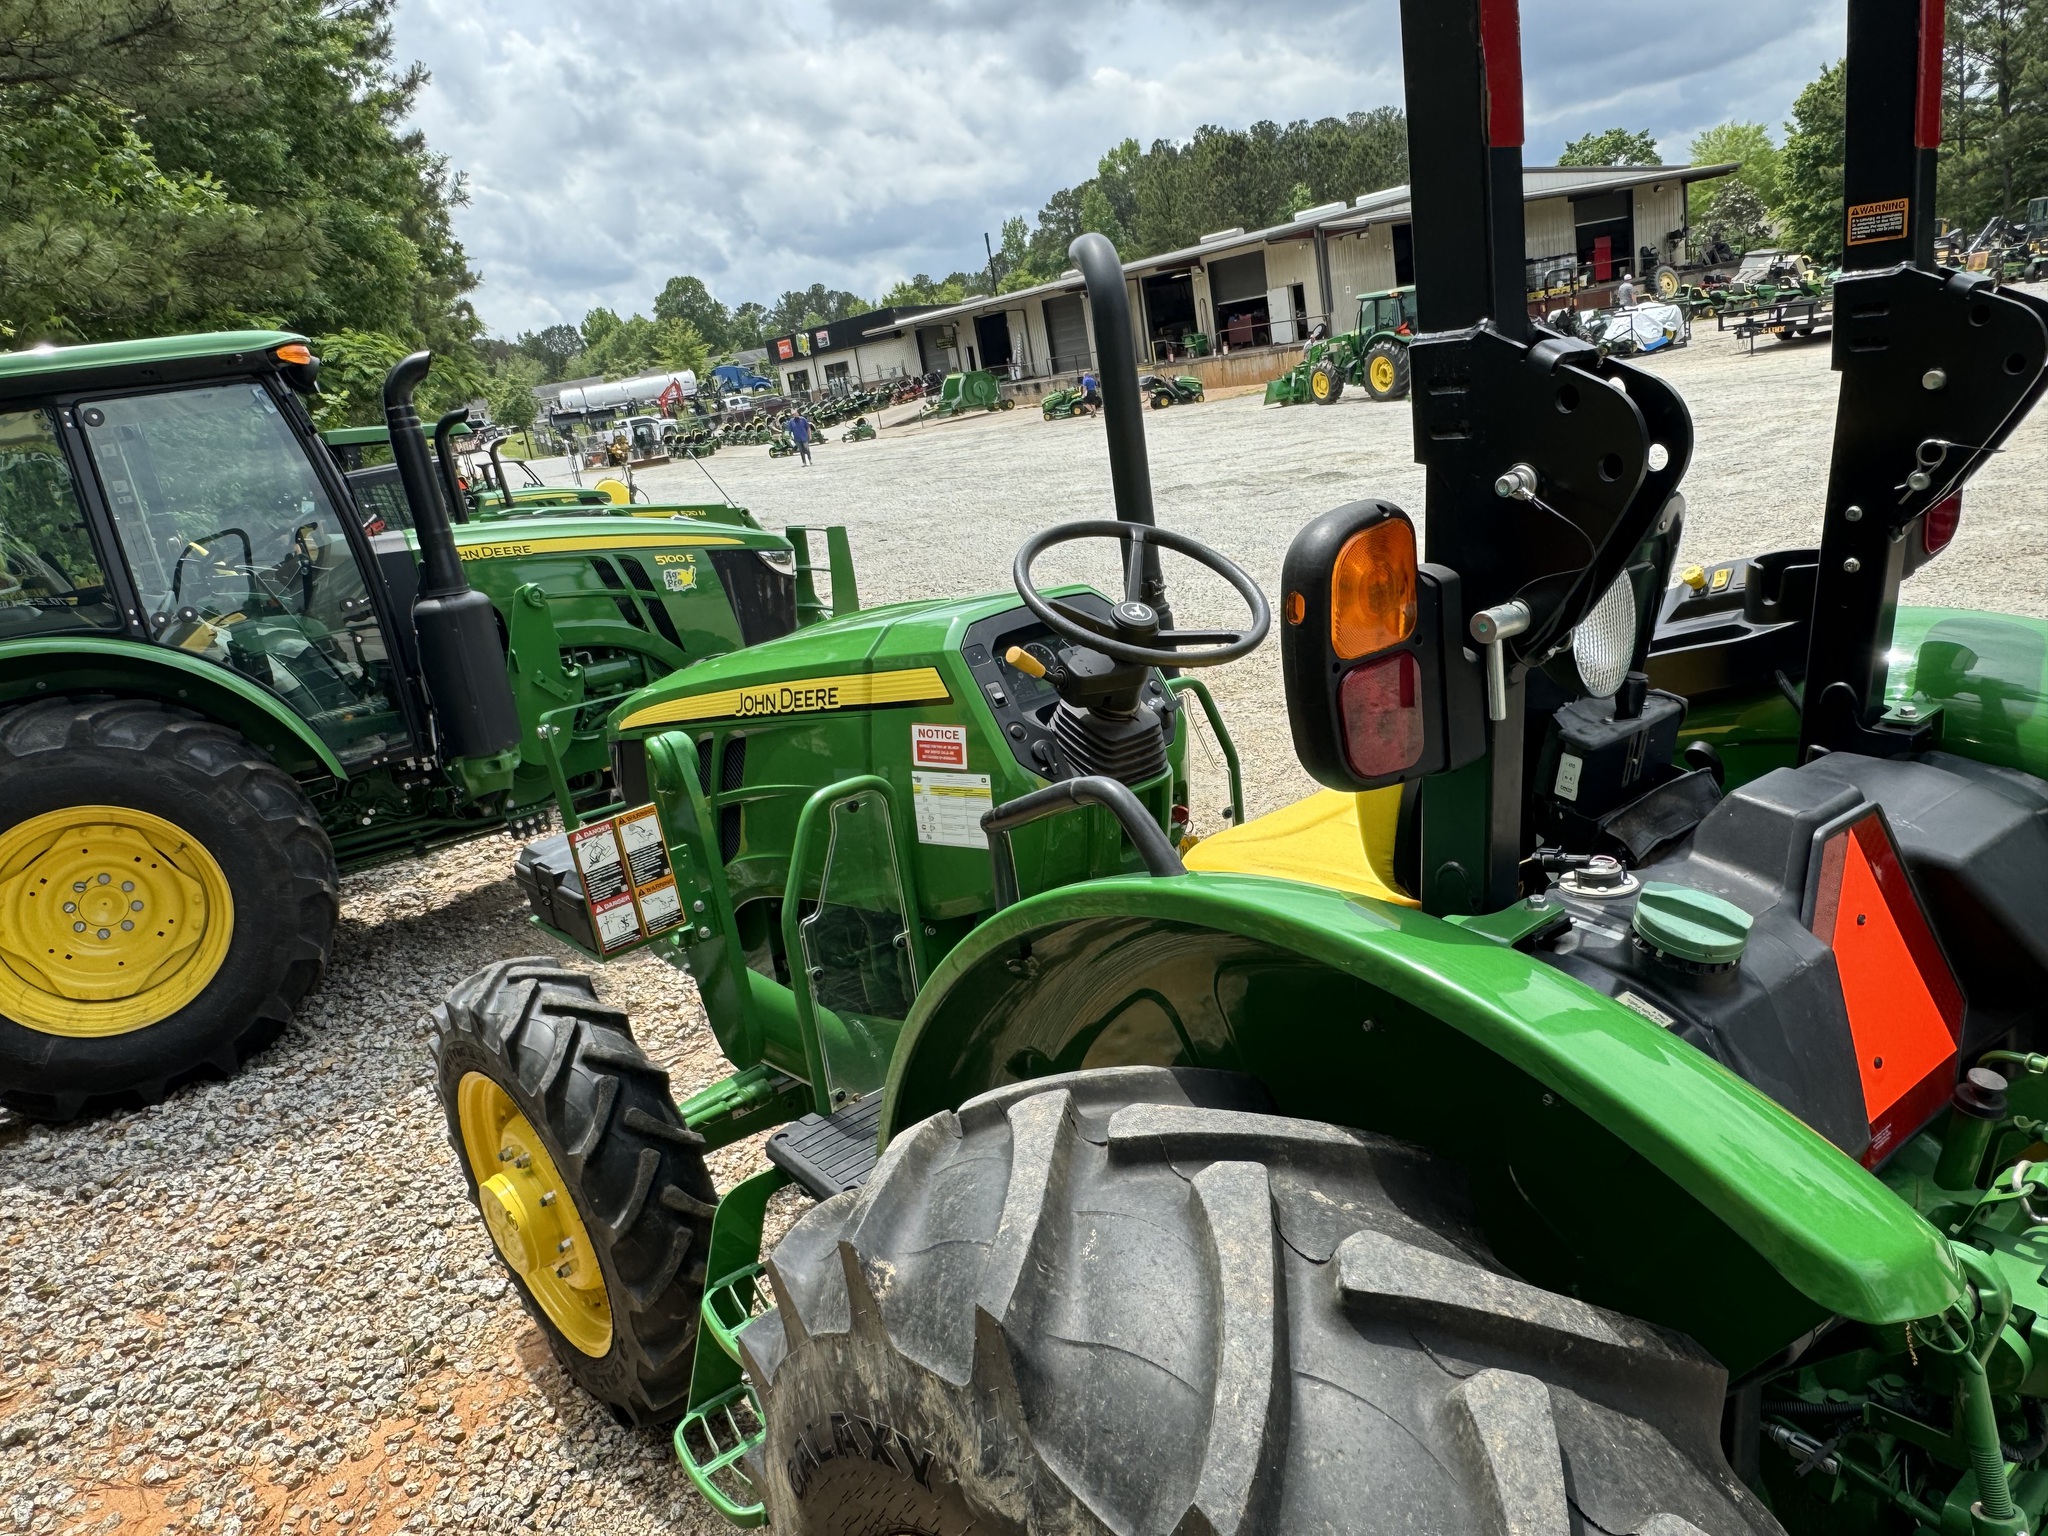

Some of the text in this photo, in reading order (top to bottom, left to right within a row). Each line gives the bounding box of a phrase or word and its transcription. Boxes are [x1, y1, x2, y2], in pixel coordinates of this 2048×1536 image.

[1860, 201, 1906, 215] WARNING
[457, 545, 532, 559] HN DEERE
[736, 687, 839, 714] JOHN DEERE
[918, 728, 960, 740] NOTICE
[583, 823, 611, 838] DANGER
[604, 895, 631, 910] DANGER
[788, 1411, 936, 1500] GALAXY
